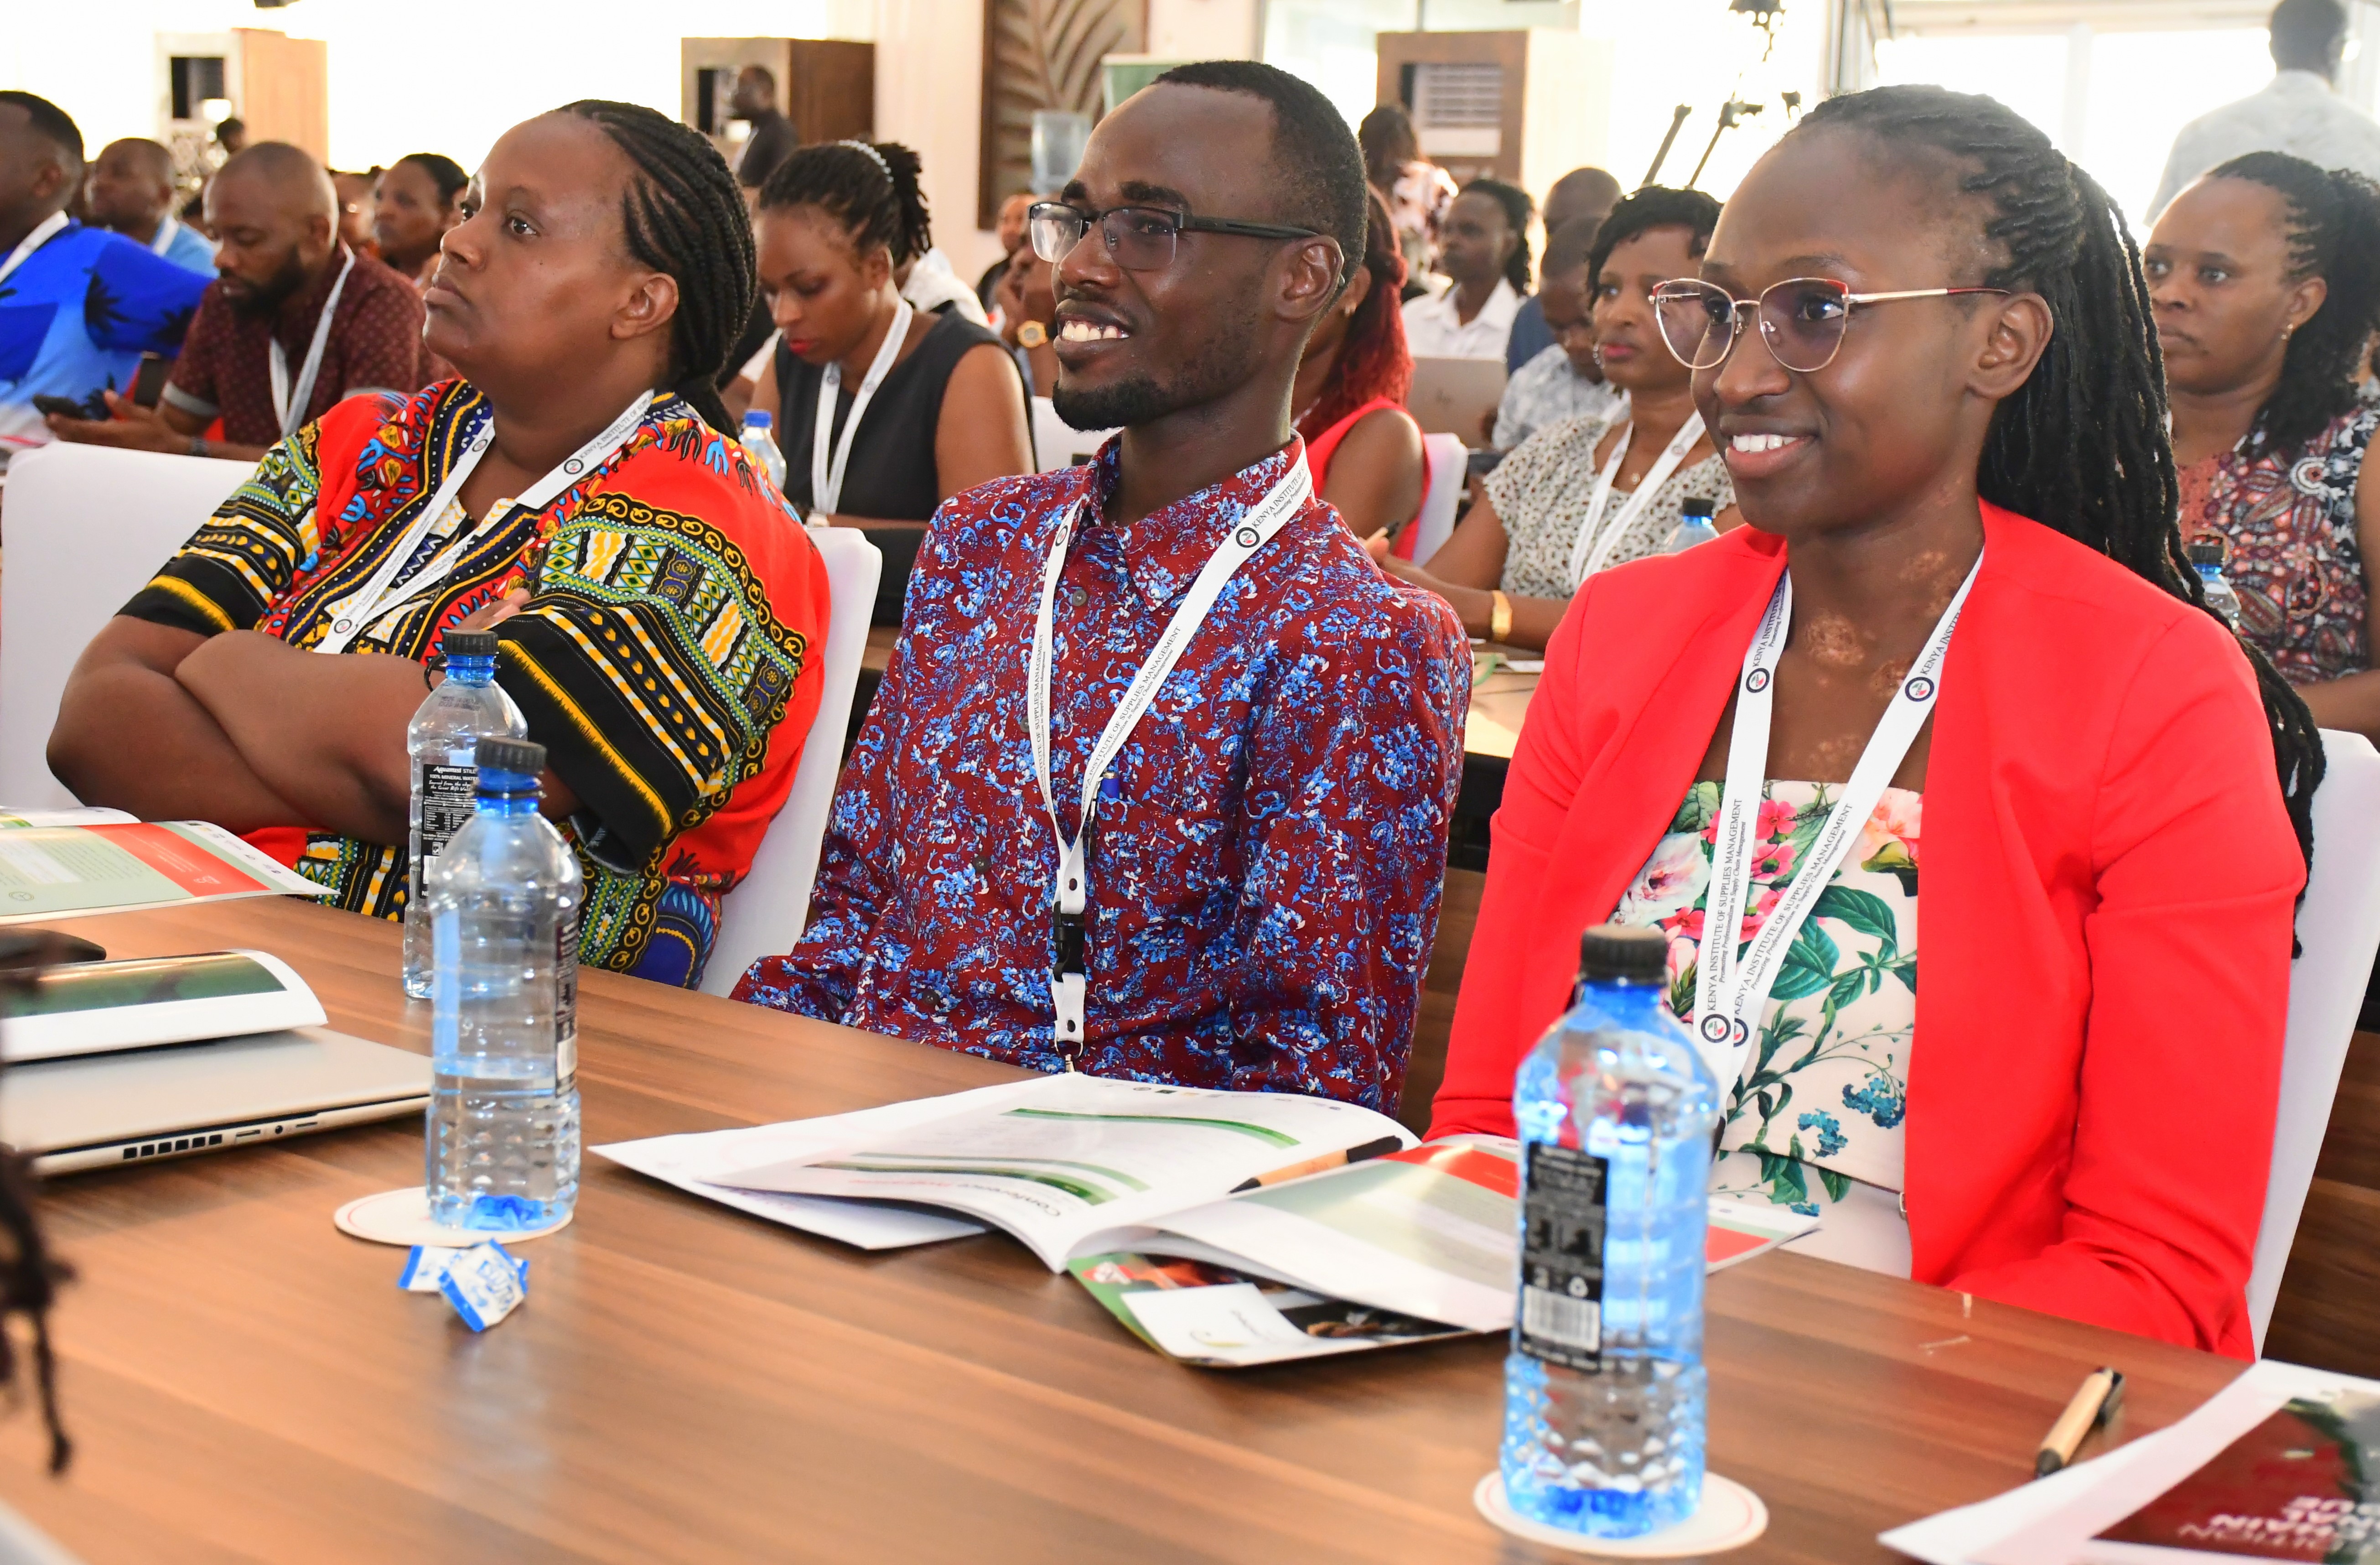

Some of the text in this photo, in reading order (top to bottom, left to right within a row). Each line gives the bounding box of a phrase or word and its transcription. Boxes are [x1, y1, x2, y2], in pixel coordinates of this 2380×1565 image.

[601, 417, 630, 442] INSTITUTE
[1251, 470, 1303, 528] KENYA INSTITUTE OF
[1273, 499, 1292, 519] Promoting
[1034, 634, 1043, 691] MANAGEMENT
[1753, 641, 1768, 667] KENYA
[1762, 600, 1779, 640] INSTITUTE
[1768, 621, 1782, 647] Promoting
[1920, 607, 1962, 675] KENYA INSTIT
[1089, 733, 1114, 775] INSTITUTE
[1113, 721, 1121, 732] OF
[1120, 684, 1145, 720] SUPPLIES
[1143, 626, 1181, 684] MANAGEMENT
[1103, 720, 1129, 758] Professionalism
[1131, 696, 1144, 714] Supply
[1143, 681, 1153, 697] Chain
[1153, 649, 1174, 681] Management
[1036, 732, 1041, 742] OF
[1707, 799, 1742, 1011] KENYA INSTITUTE OF SUPPLIES MANAGEMENT
[1747, 925, 1778, 976] INSTITUTE
[1775, 912, 1786, 925] OF
[1784, 872, 1813, 912] SUPPLIES
[1810, 803, 1852, 870] MANAGEMENT
[1751, 954, 1771, 990] Promoting
[1767, 910, 1796, 956] Professionalism
[1798, 883, 1813, 903] Supply
[1810, 866, 1824, 883] Chain
[1824, 830, 1846, 865] Management
[1722, 905, 1734, 949] Professionalism
[1719, 950, 1729, 983] Promoting
